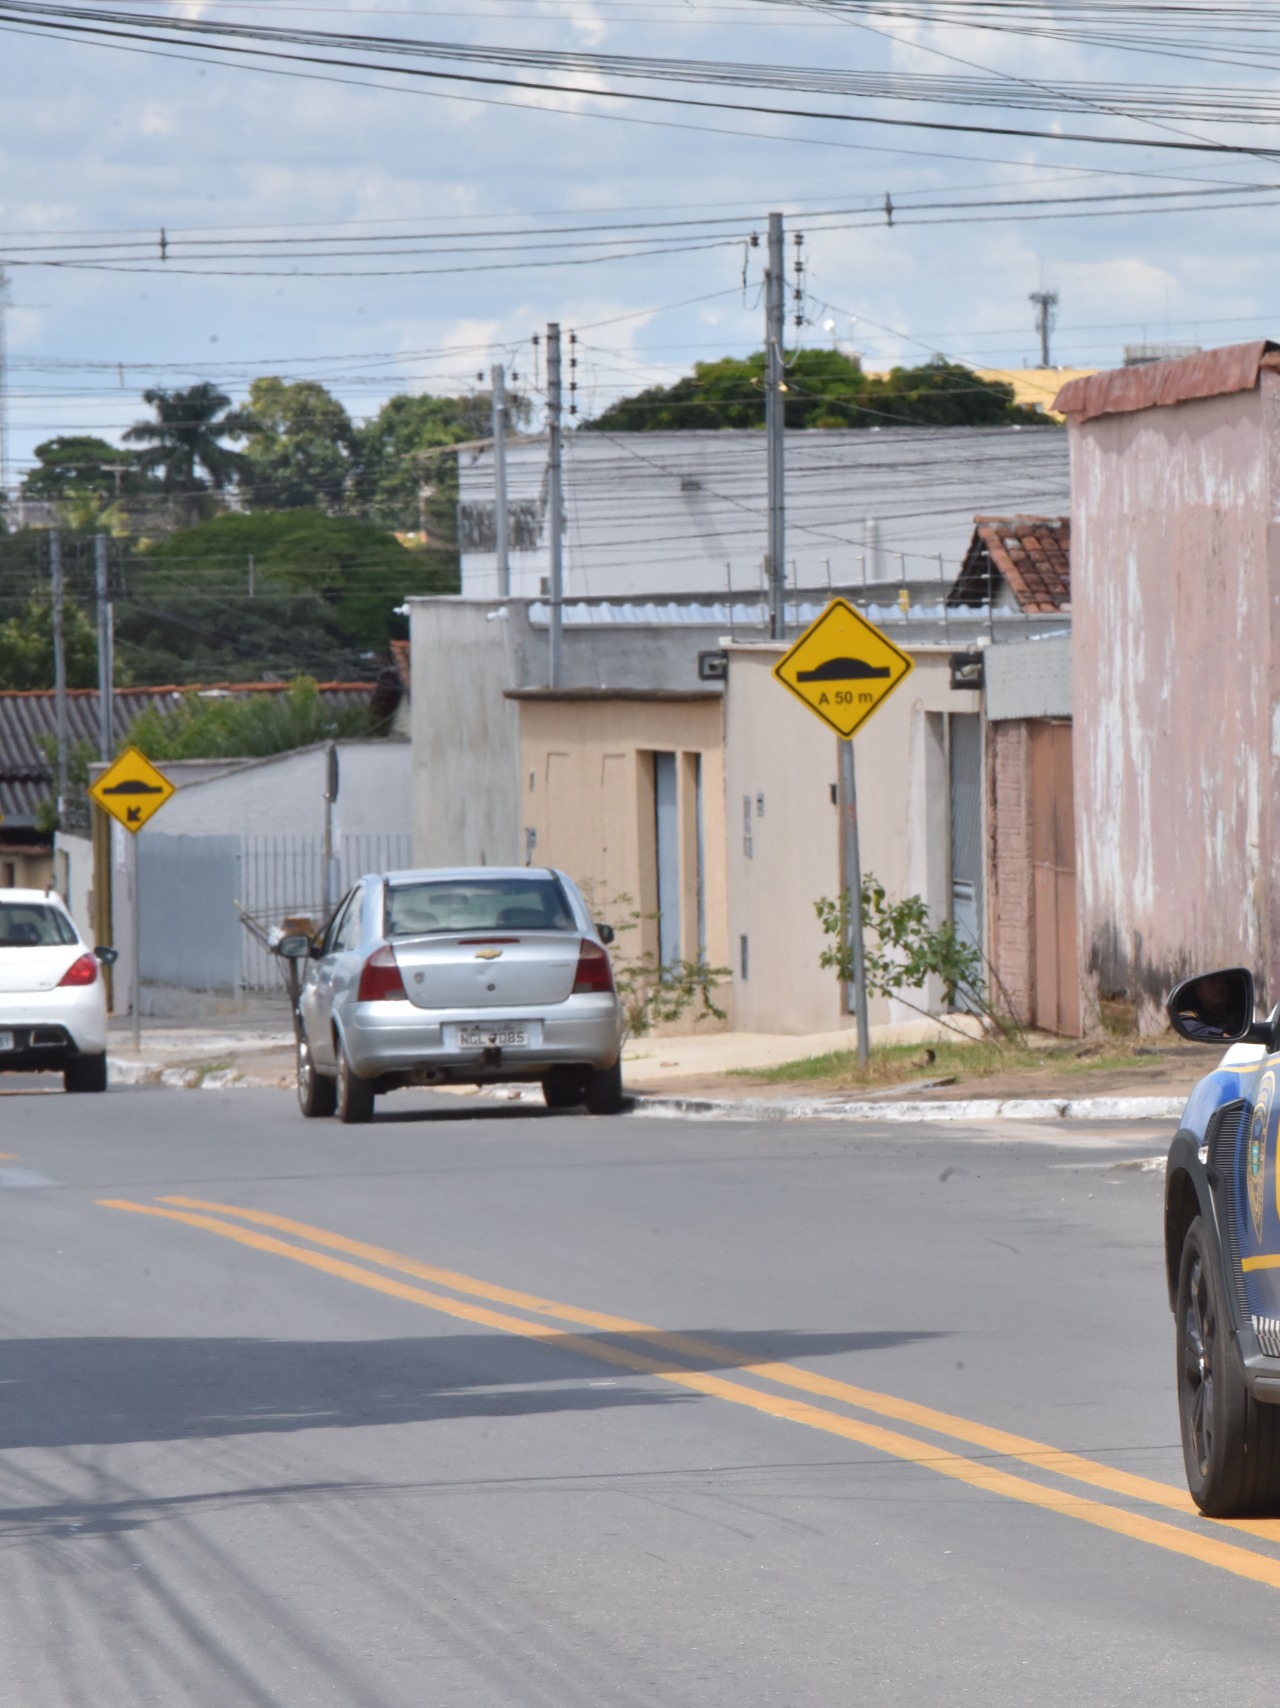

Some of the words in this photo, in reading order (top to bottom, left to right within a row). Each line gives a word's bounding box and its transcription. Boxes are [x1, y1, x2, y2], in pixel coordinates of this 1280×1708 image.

[818, 692, 830, 705] A
[835, 691, 853, 704] 50
[858, 692, 873, 704] m
